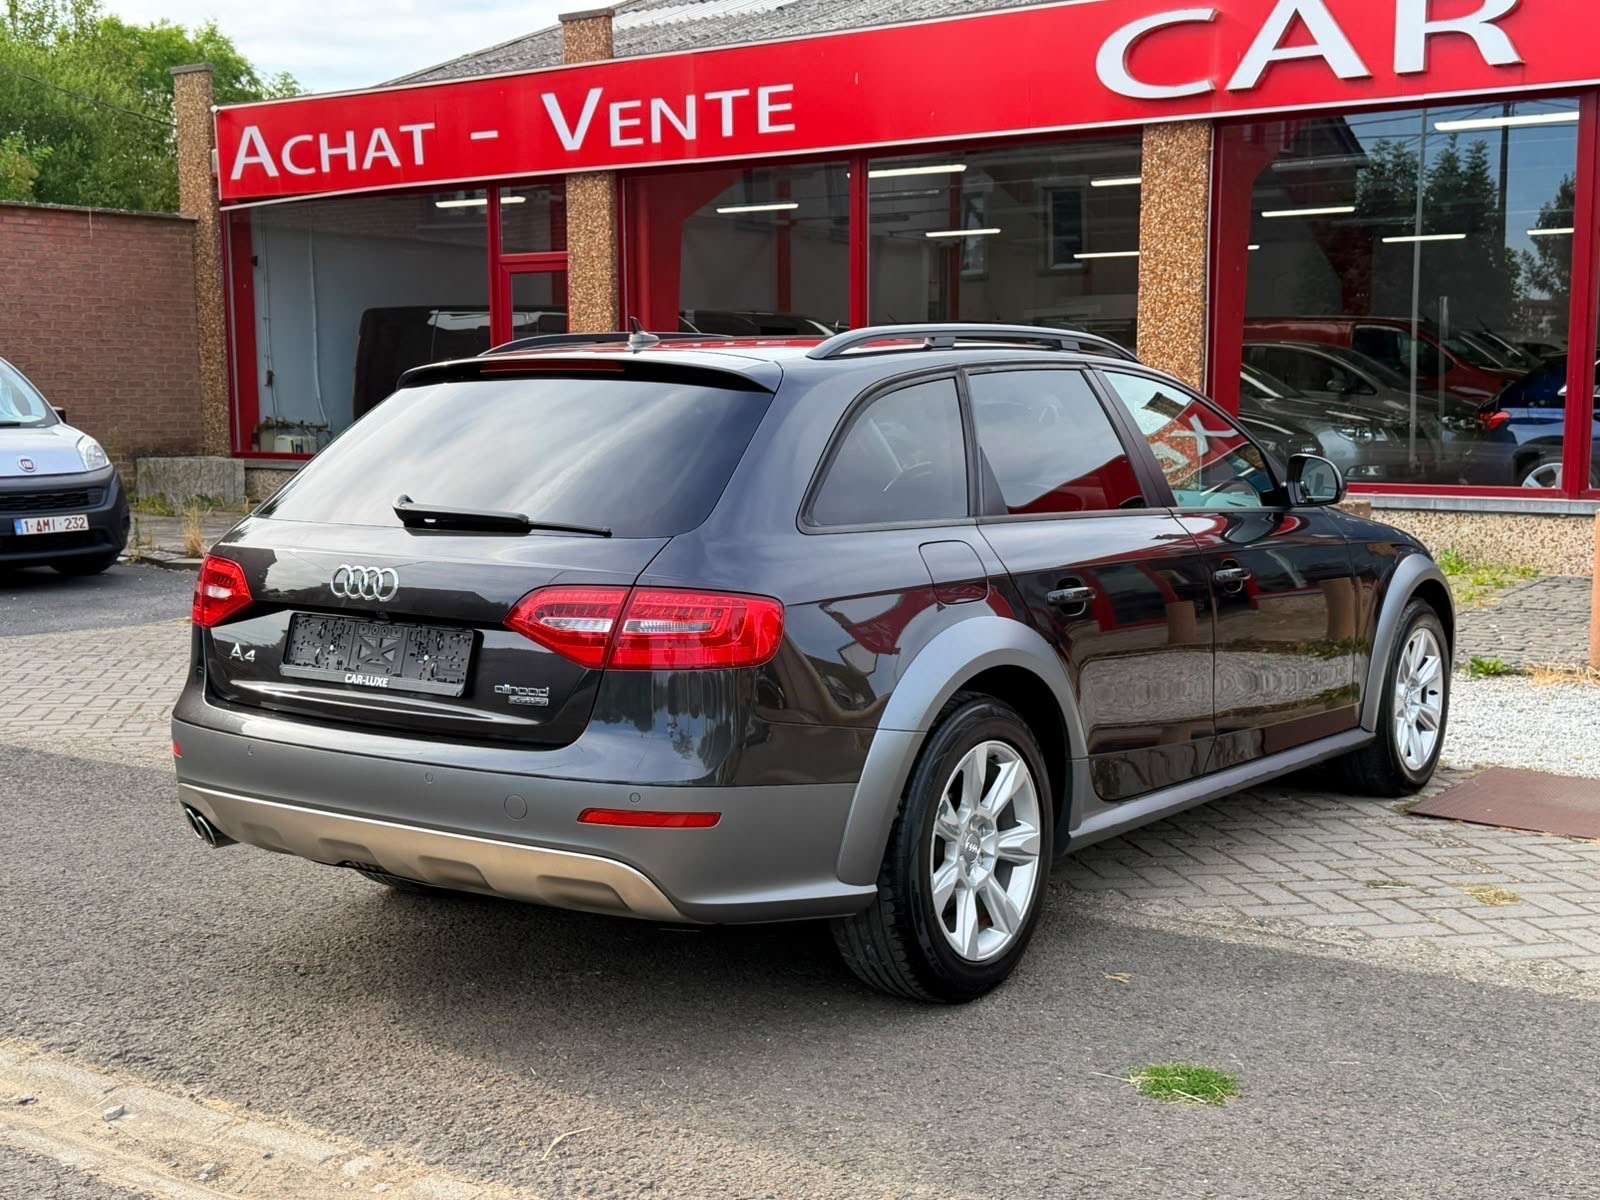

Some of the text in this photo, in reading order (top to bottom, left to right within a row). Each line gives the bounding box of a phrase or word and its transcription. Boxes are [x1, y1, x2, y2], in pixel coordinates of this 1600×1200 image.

[1095, 0, 1525, 99] CAR
[231, 122, 436, 180] ACHAT
[541, 85, 796, 151] VENTE
[229, 642, 256, 662] A4
[344, 673, 389, 688] CAR-LUXE
